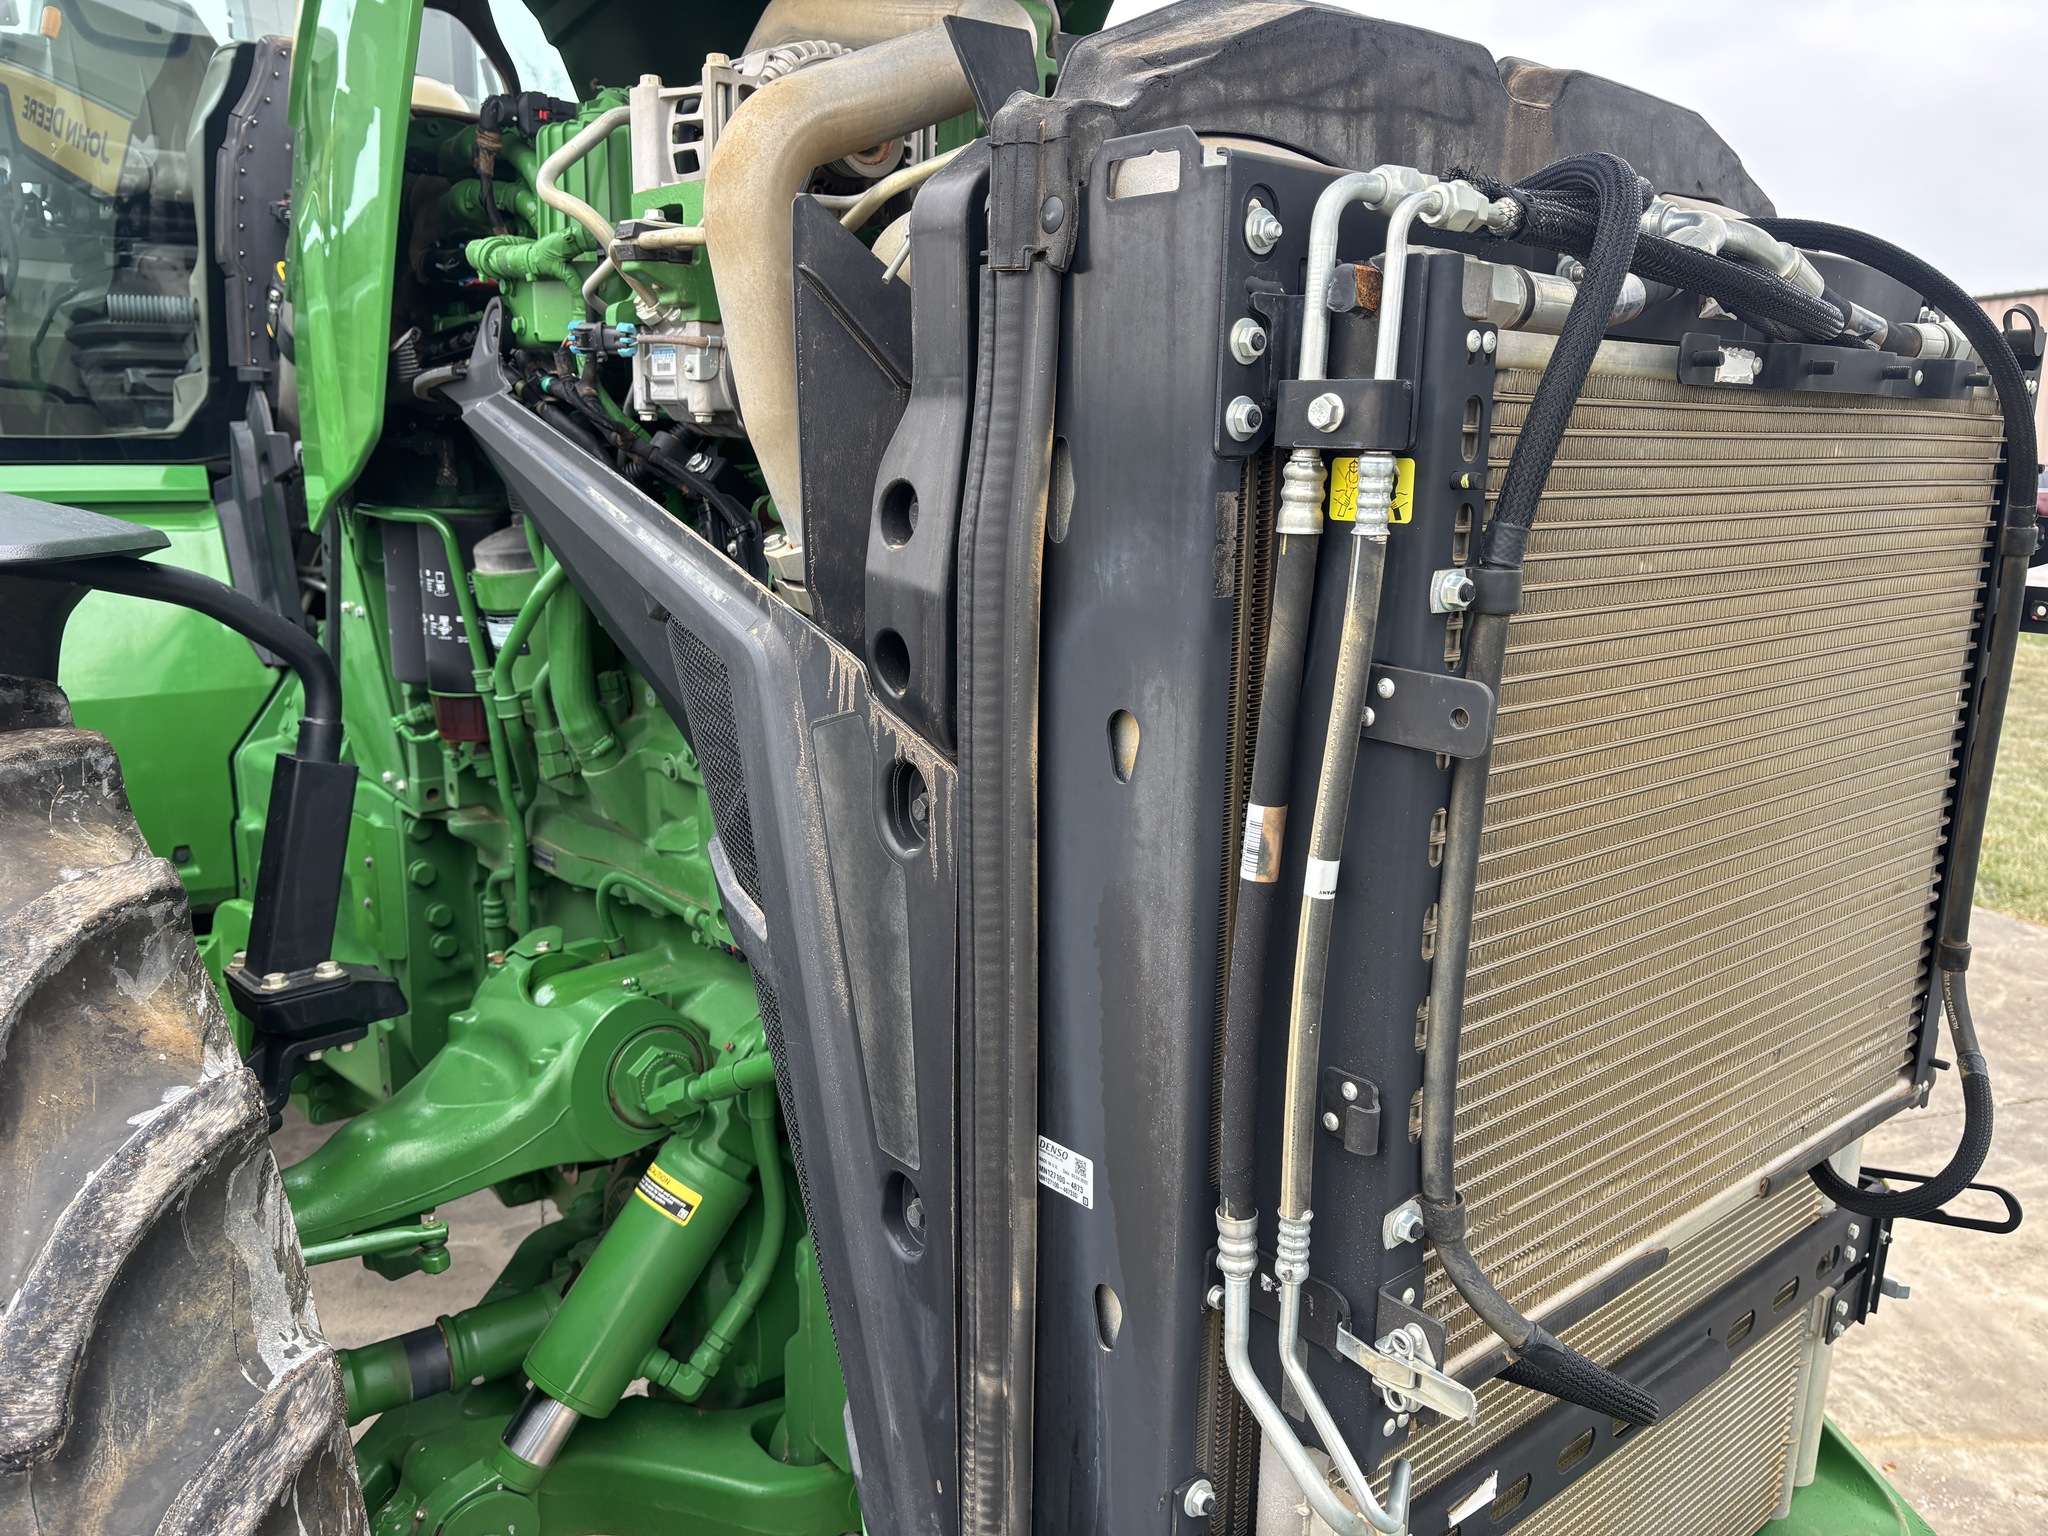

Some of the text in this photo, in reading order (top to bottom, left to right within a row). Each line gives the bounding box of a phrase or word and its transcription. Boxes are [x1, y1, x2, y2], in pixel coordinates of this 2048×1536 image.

[1338, 644, 1350, 694] GALAXY
[1329, 734, 1337, 748] A/C
[1325, 749, 1335, 773] HOSE
[1039, 1139, 1069, 1160] DENSO
